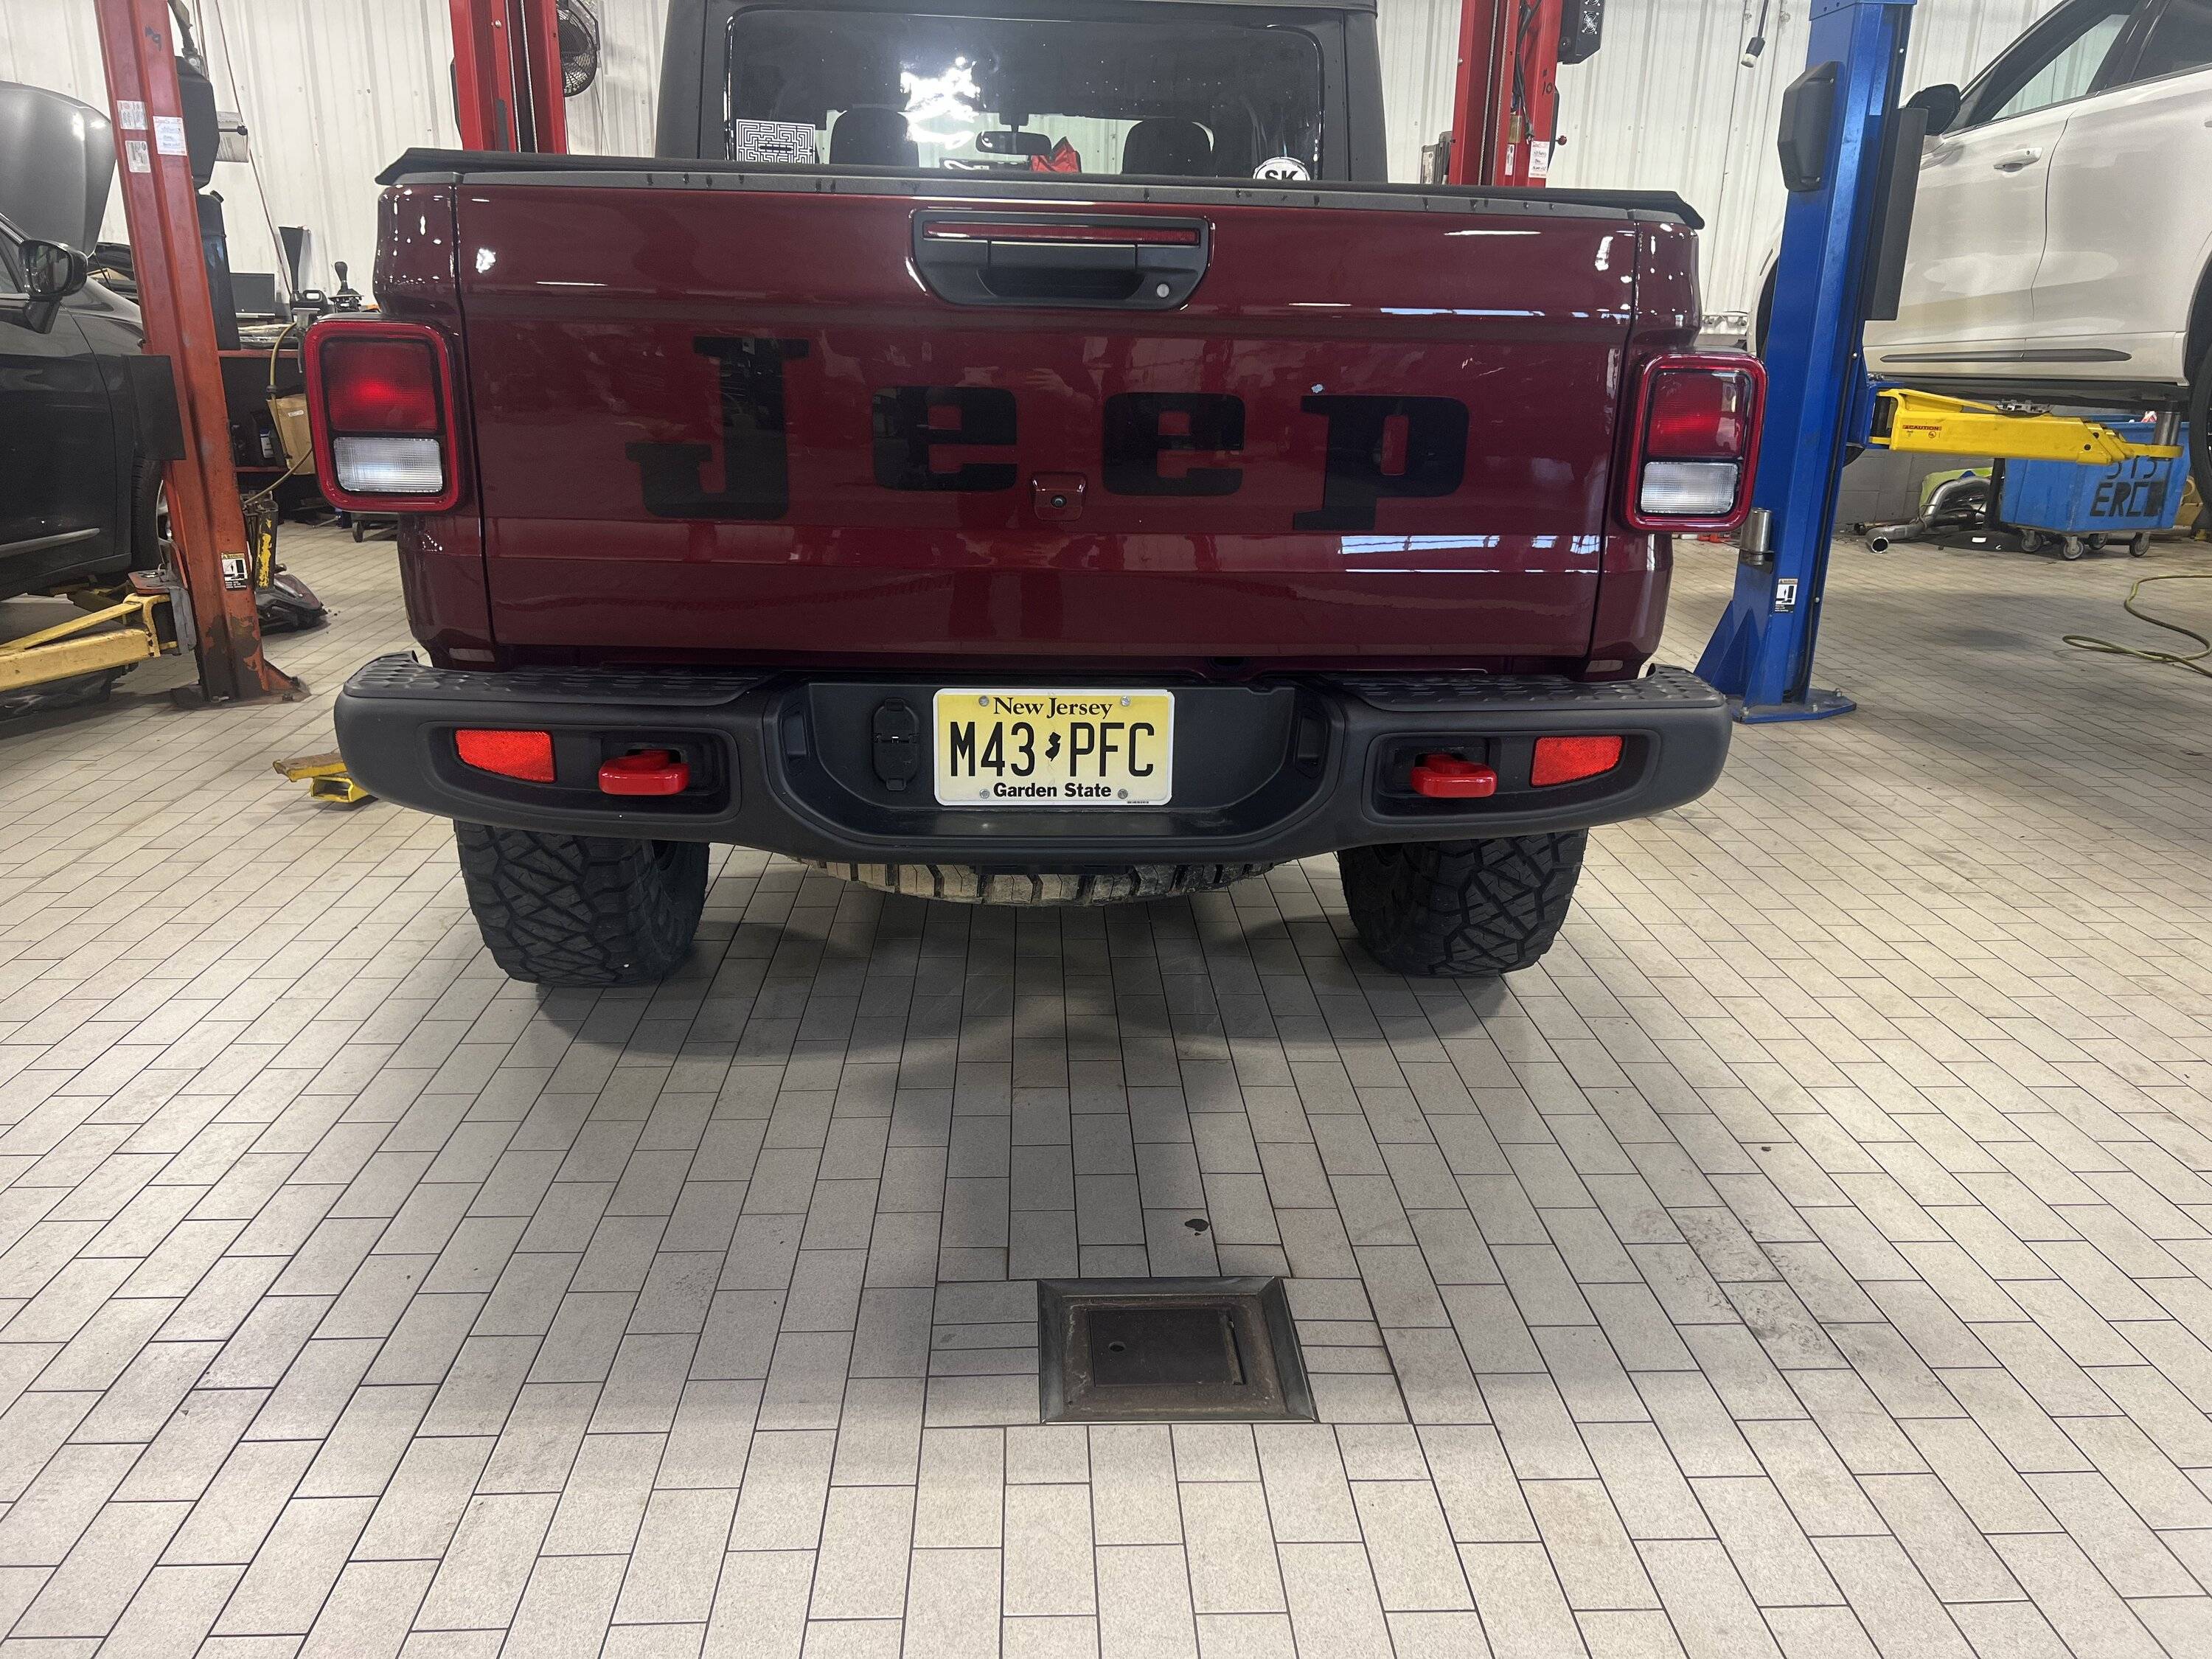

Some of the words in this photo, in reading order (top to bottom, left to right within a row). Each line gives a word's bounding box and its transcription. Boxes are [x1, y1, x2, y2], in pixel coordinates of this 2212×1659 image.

[626, 336, 1470, 531] Jeep
[993, 697, 1044, 715] New
[1046, 697, 1113, 720] Jersey
[993, 782, 1057, 797] Garden
[1064, 782, 1112, 797] State
